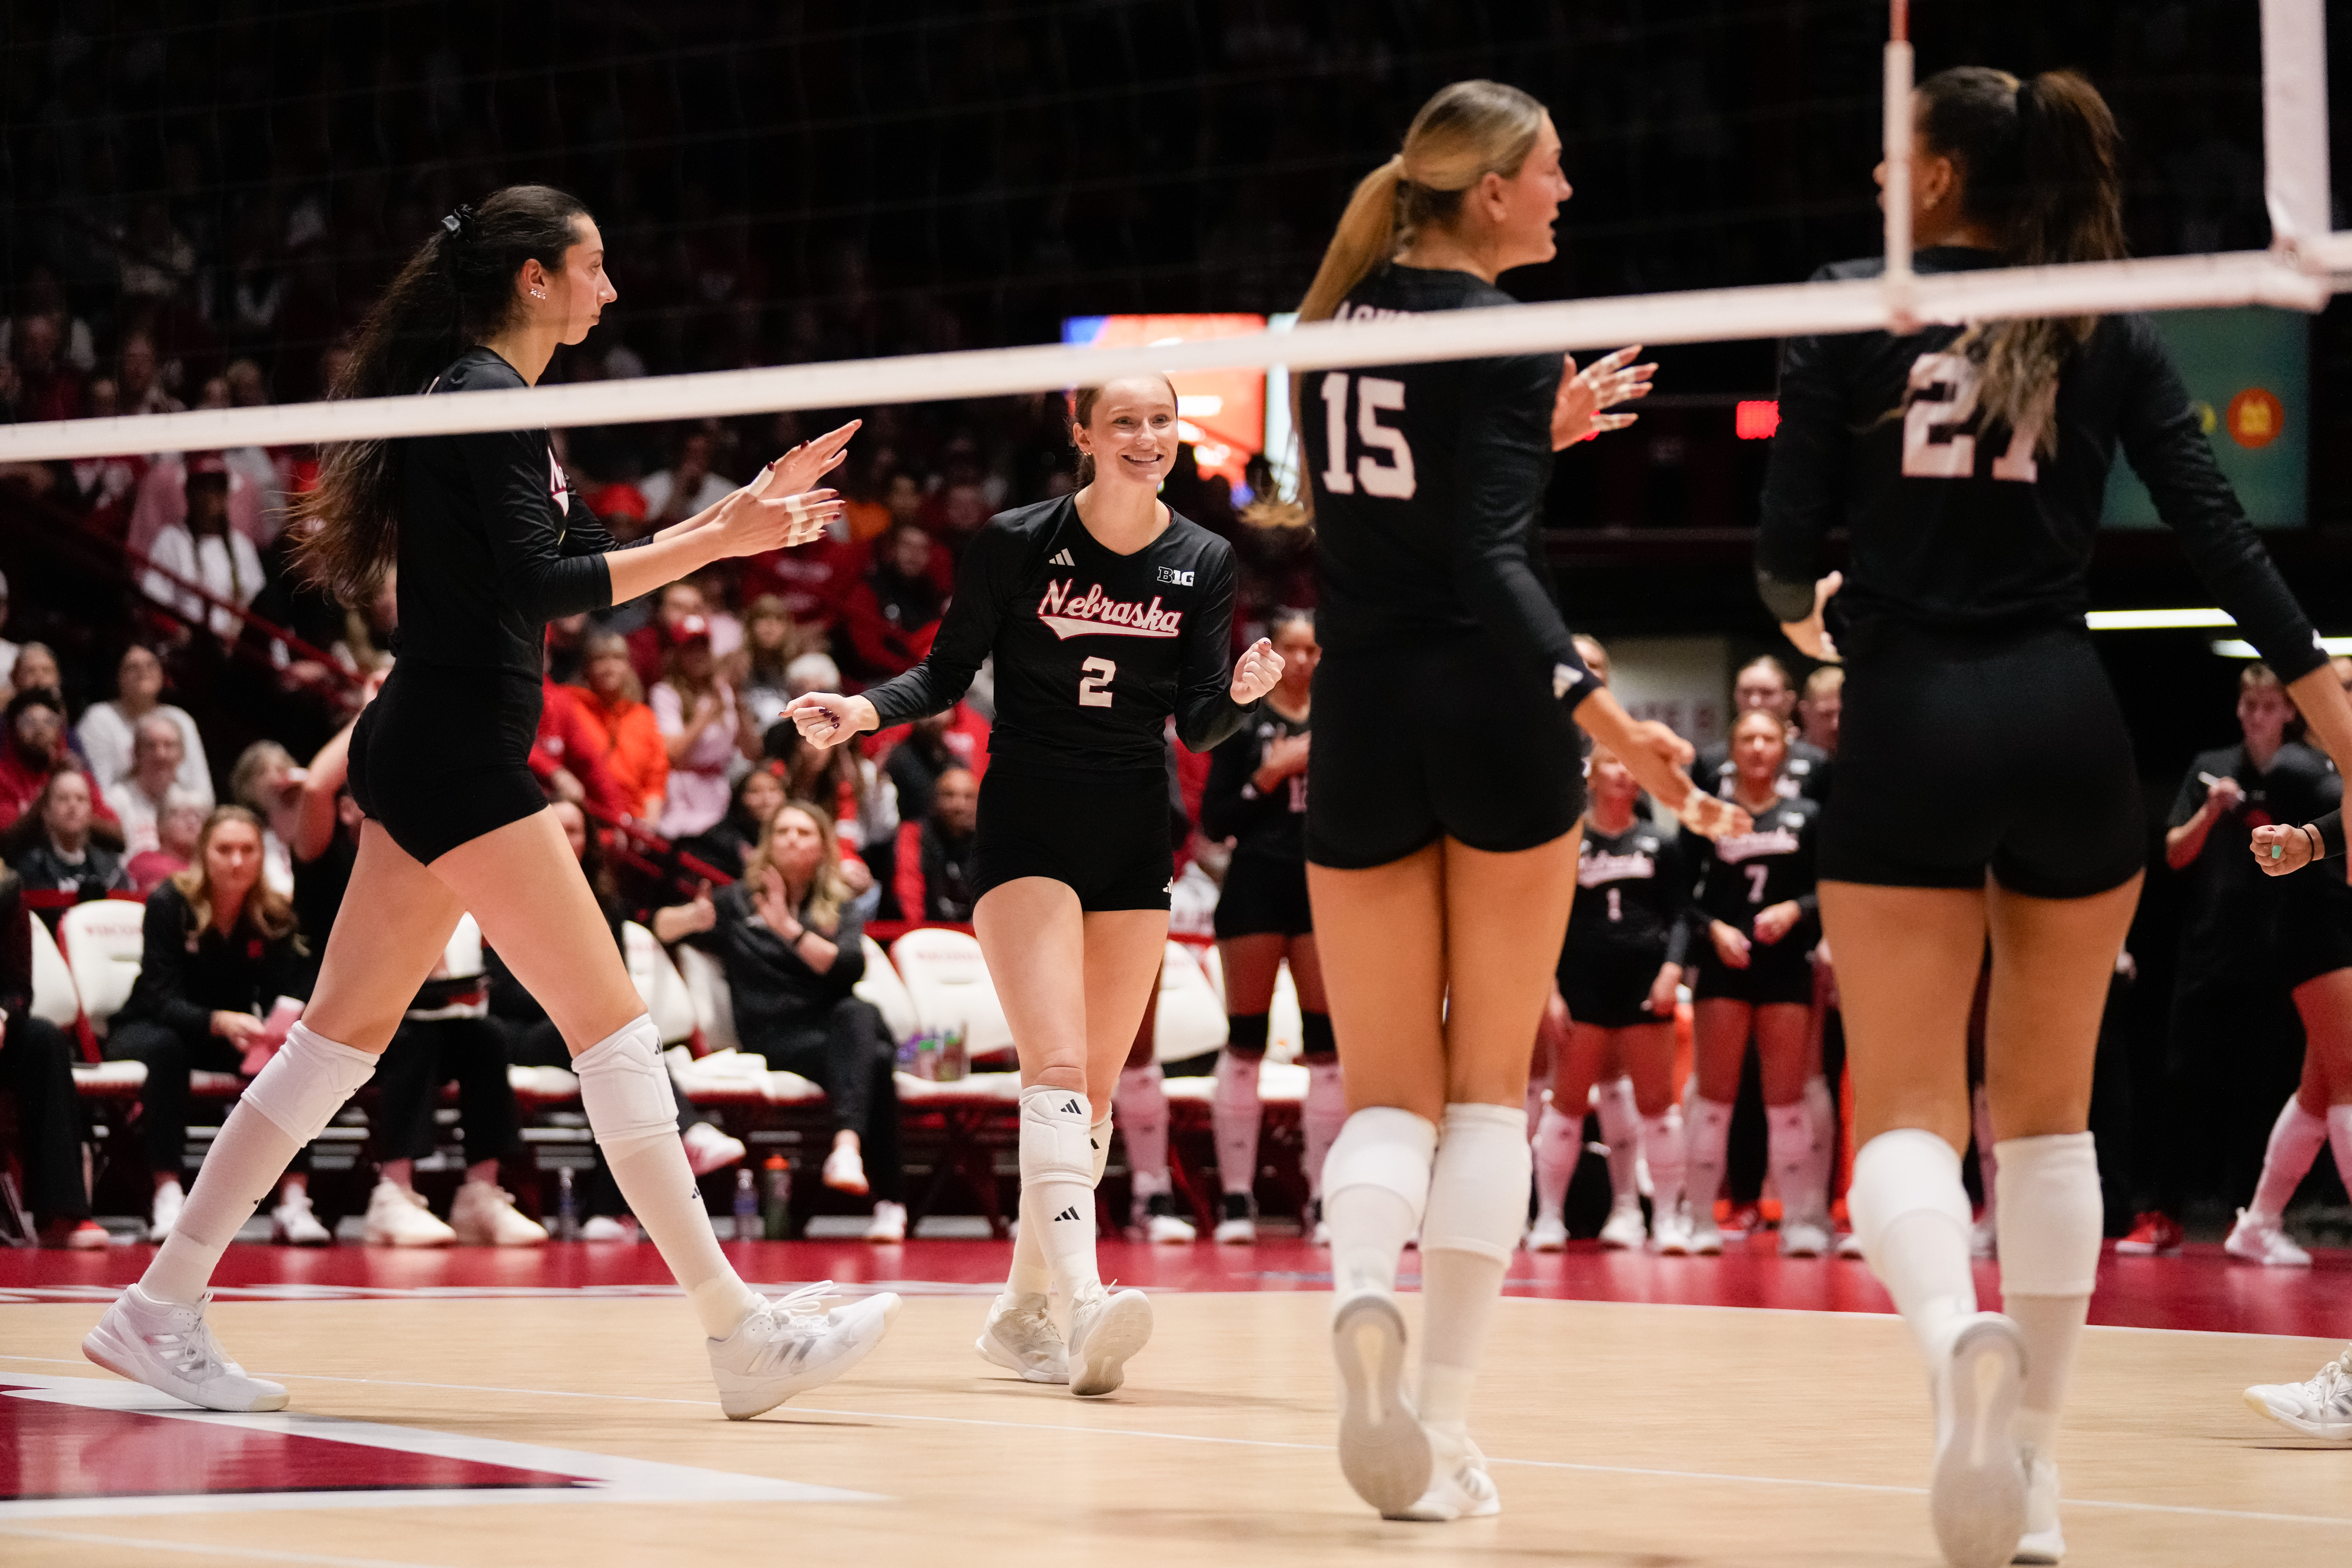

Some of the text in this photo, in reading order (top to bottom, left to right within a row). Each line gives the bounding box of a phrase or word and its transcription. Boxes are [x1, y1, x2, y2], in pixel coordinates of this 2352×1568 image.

[1321, 372, 1417, 500] 15
[1037, 577, 1184, 634] Nebraska
[1079, 656, 1116, 707] 2
[1606, 888, 1622, 922] 1
[1744, 864, 1769, 904] 7
